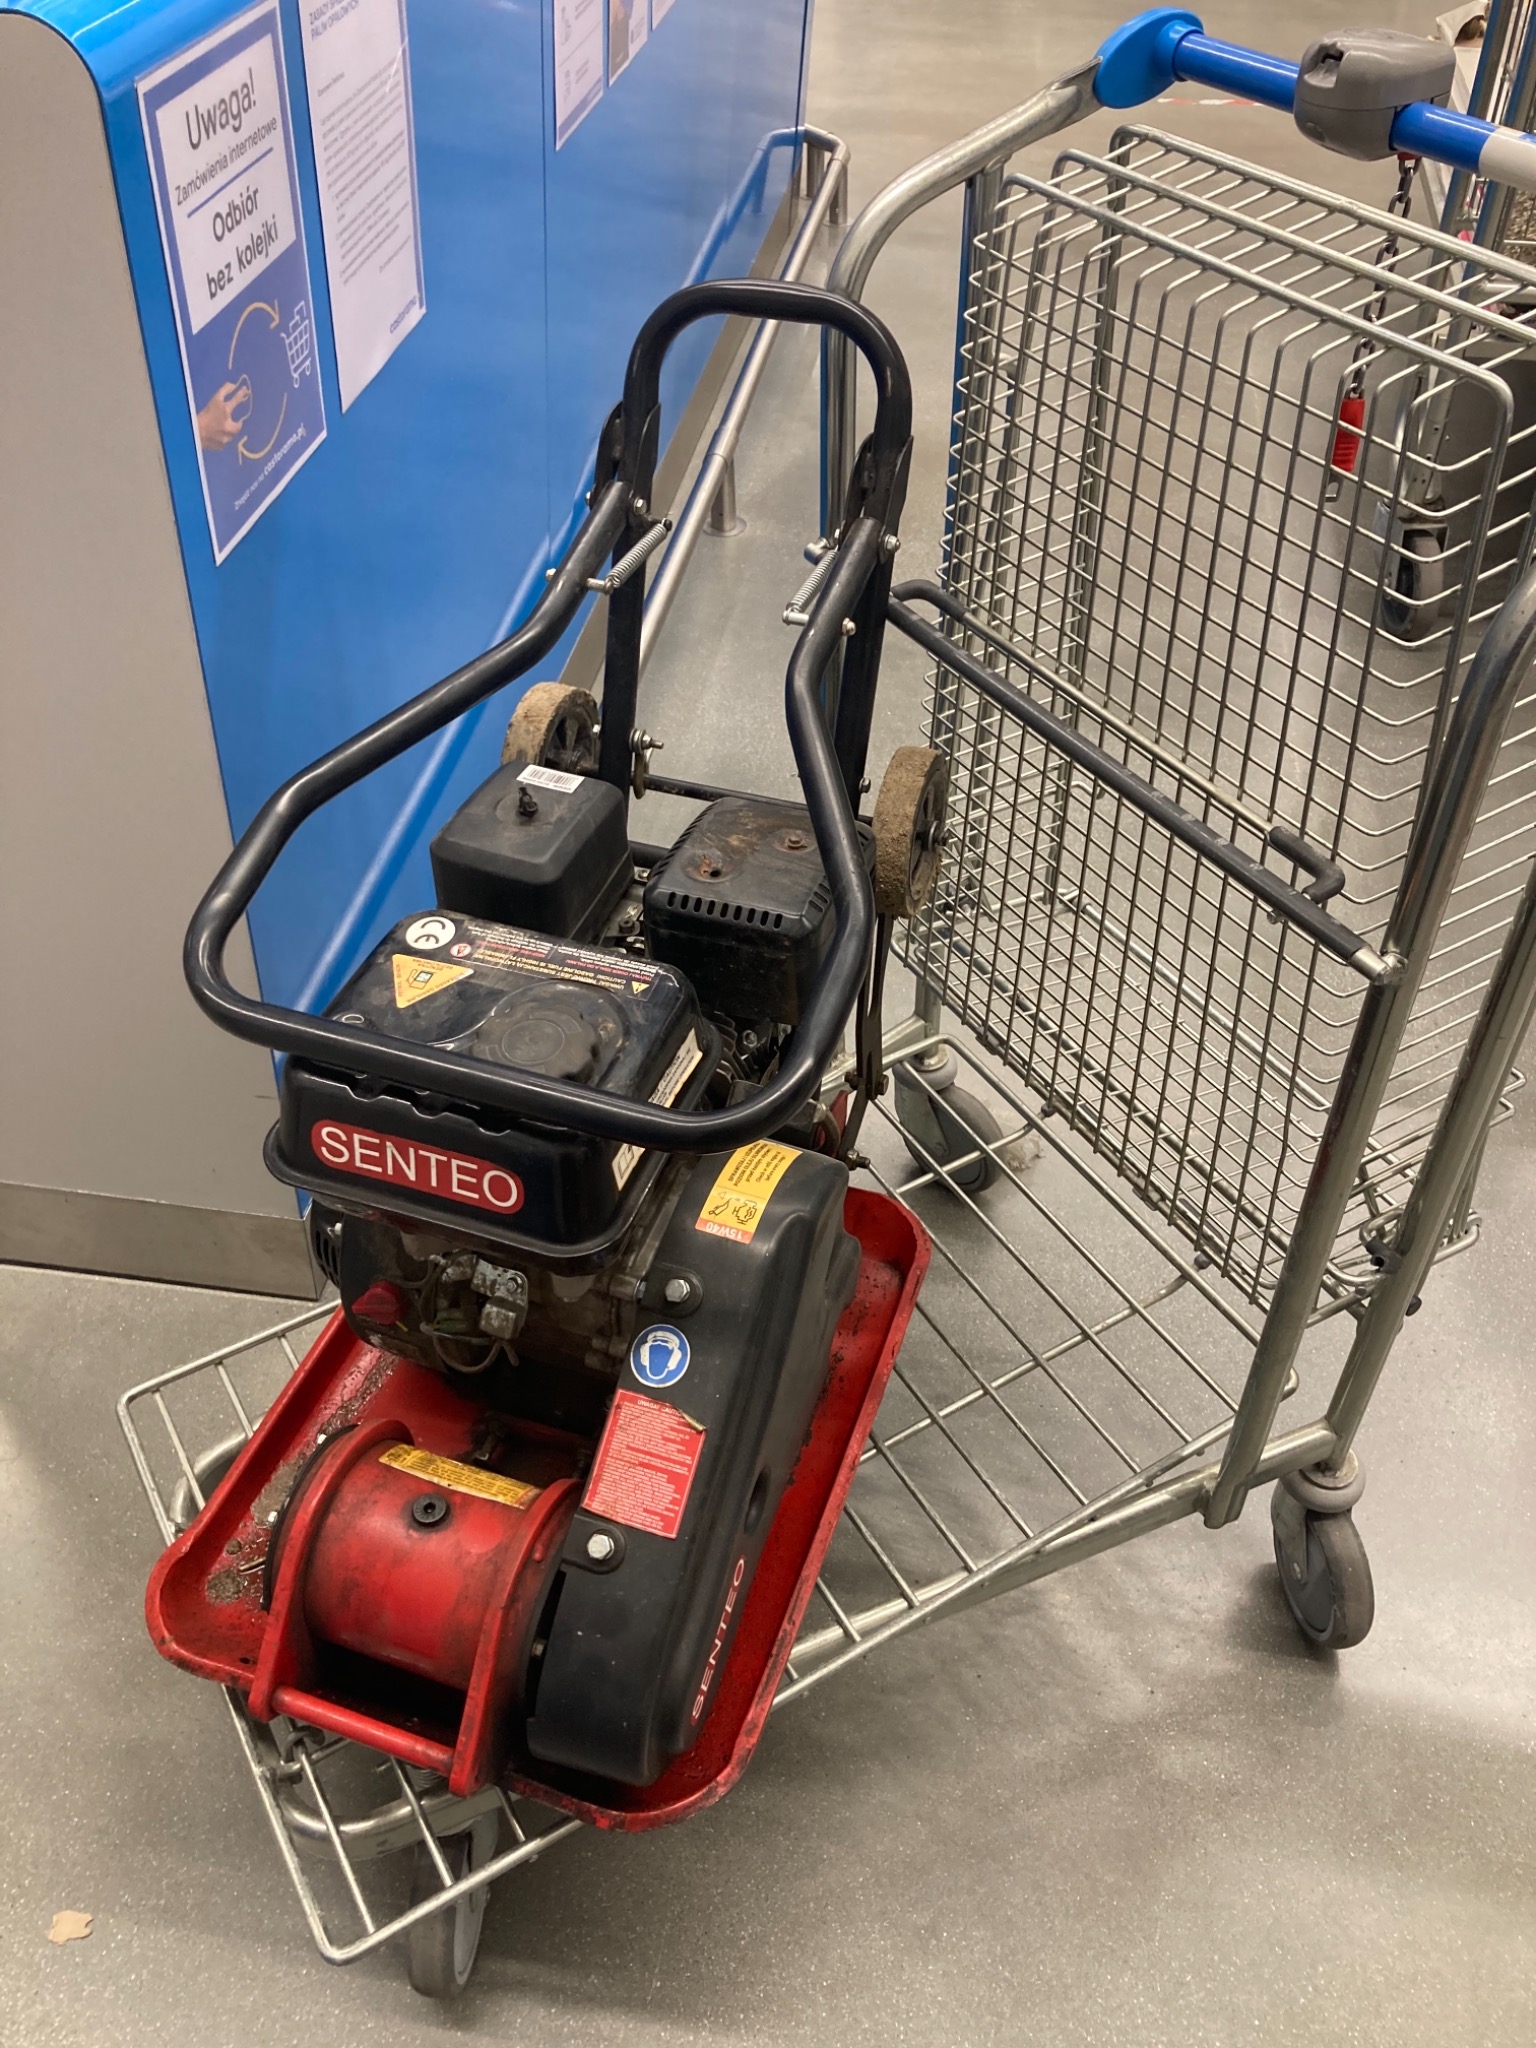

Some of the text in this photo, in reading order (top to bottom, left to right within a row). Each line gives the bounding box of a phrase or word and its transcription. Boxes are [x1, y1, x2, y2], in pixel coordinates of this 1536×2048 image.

[185, 67, 256, 150] Uwaga!
[174, 117, 277, 206] Zamówienia internetowe
[212, 185, 259, 242] Odbiór
[206, 213, 278, 300] bez kolejki
[320, 1126, 518, 1208] SENTEO
[705, 1221, 743, 1240] 15W40
[692, 1558, 745, 1719] SENTEO
